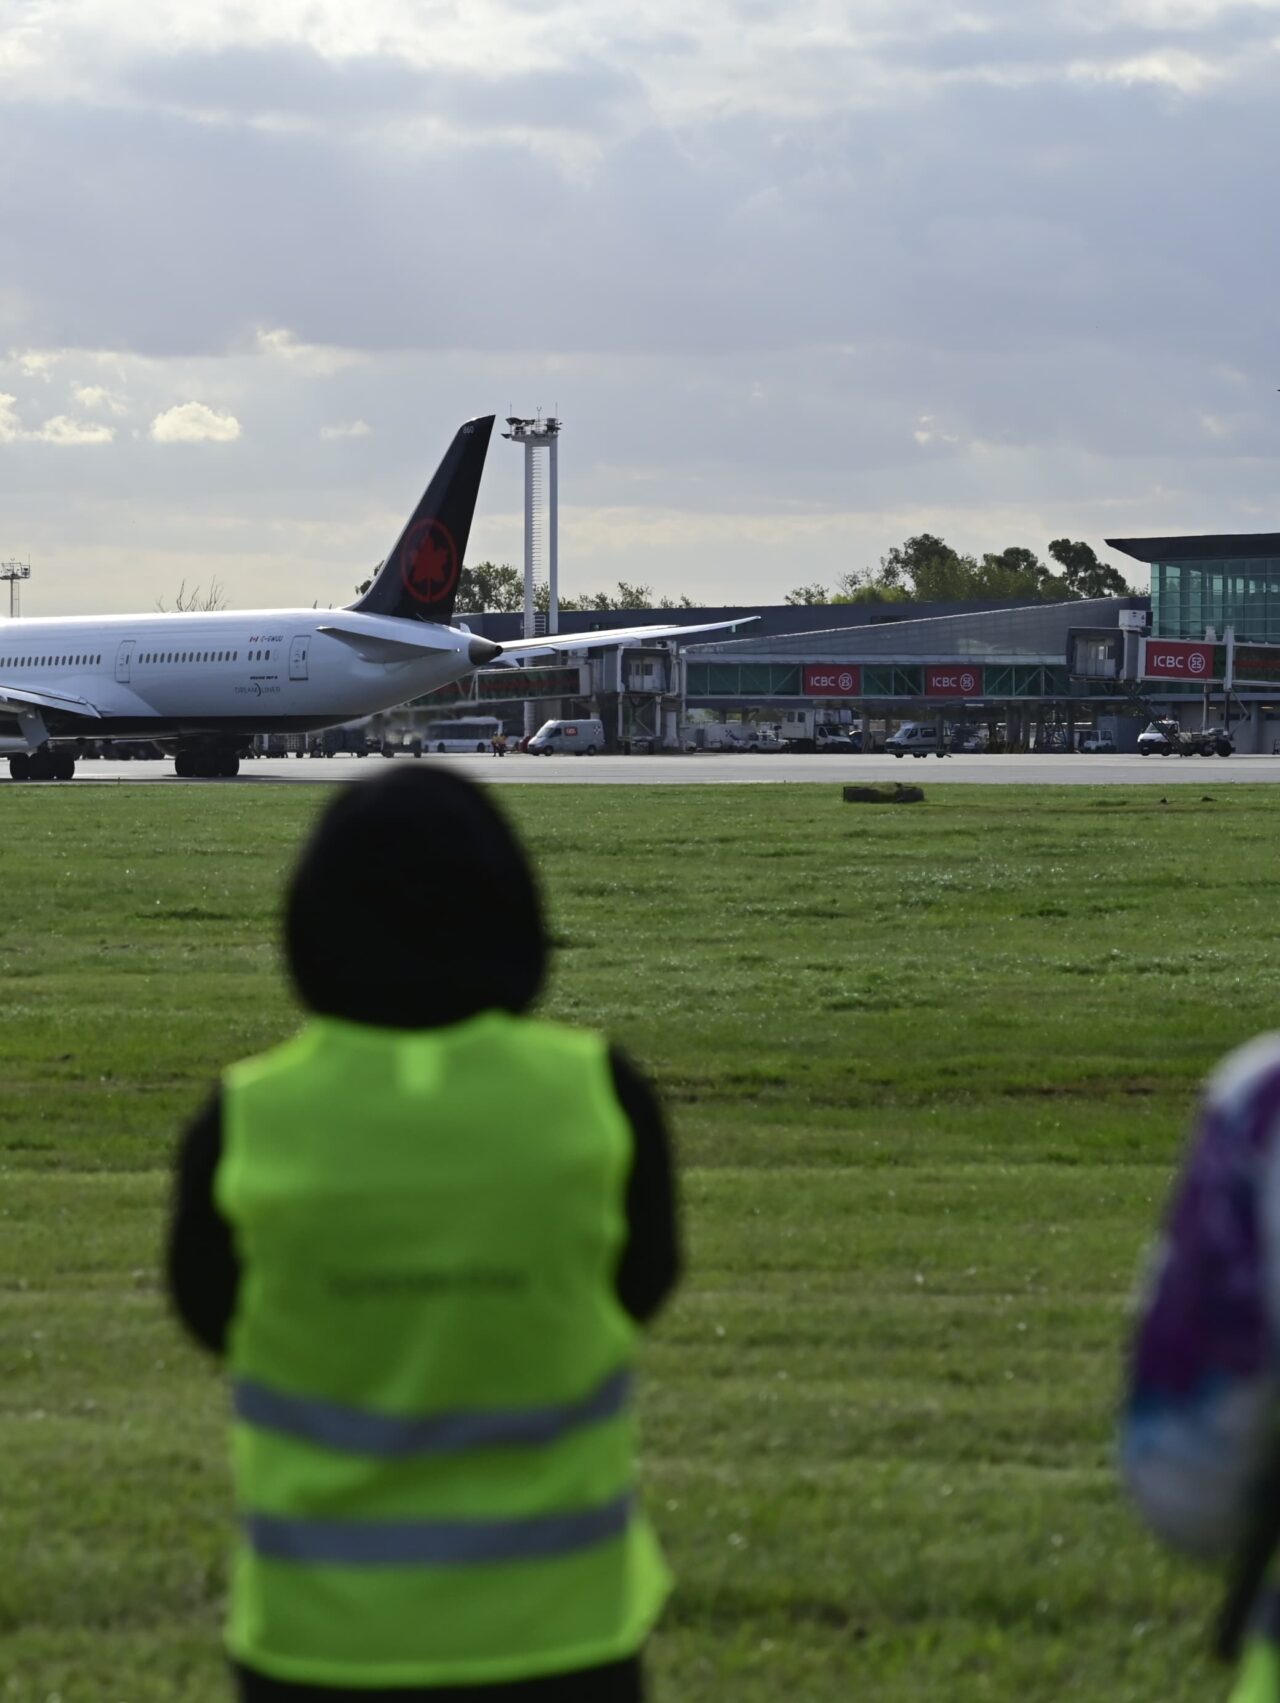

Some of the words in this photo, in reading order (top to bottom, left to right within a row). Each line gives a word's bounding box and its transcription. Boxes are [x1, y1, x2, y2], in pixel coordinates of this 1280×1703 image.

[1153, 655, 1184, 668] ICBC
[810, 676, 836, 687] ICBC
[932, 677, 957, 687] ICBC
